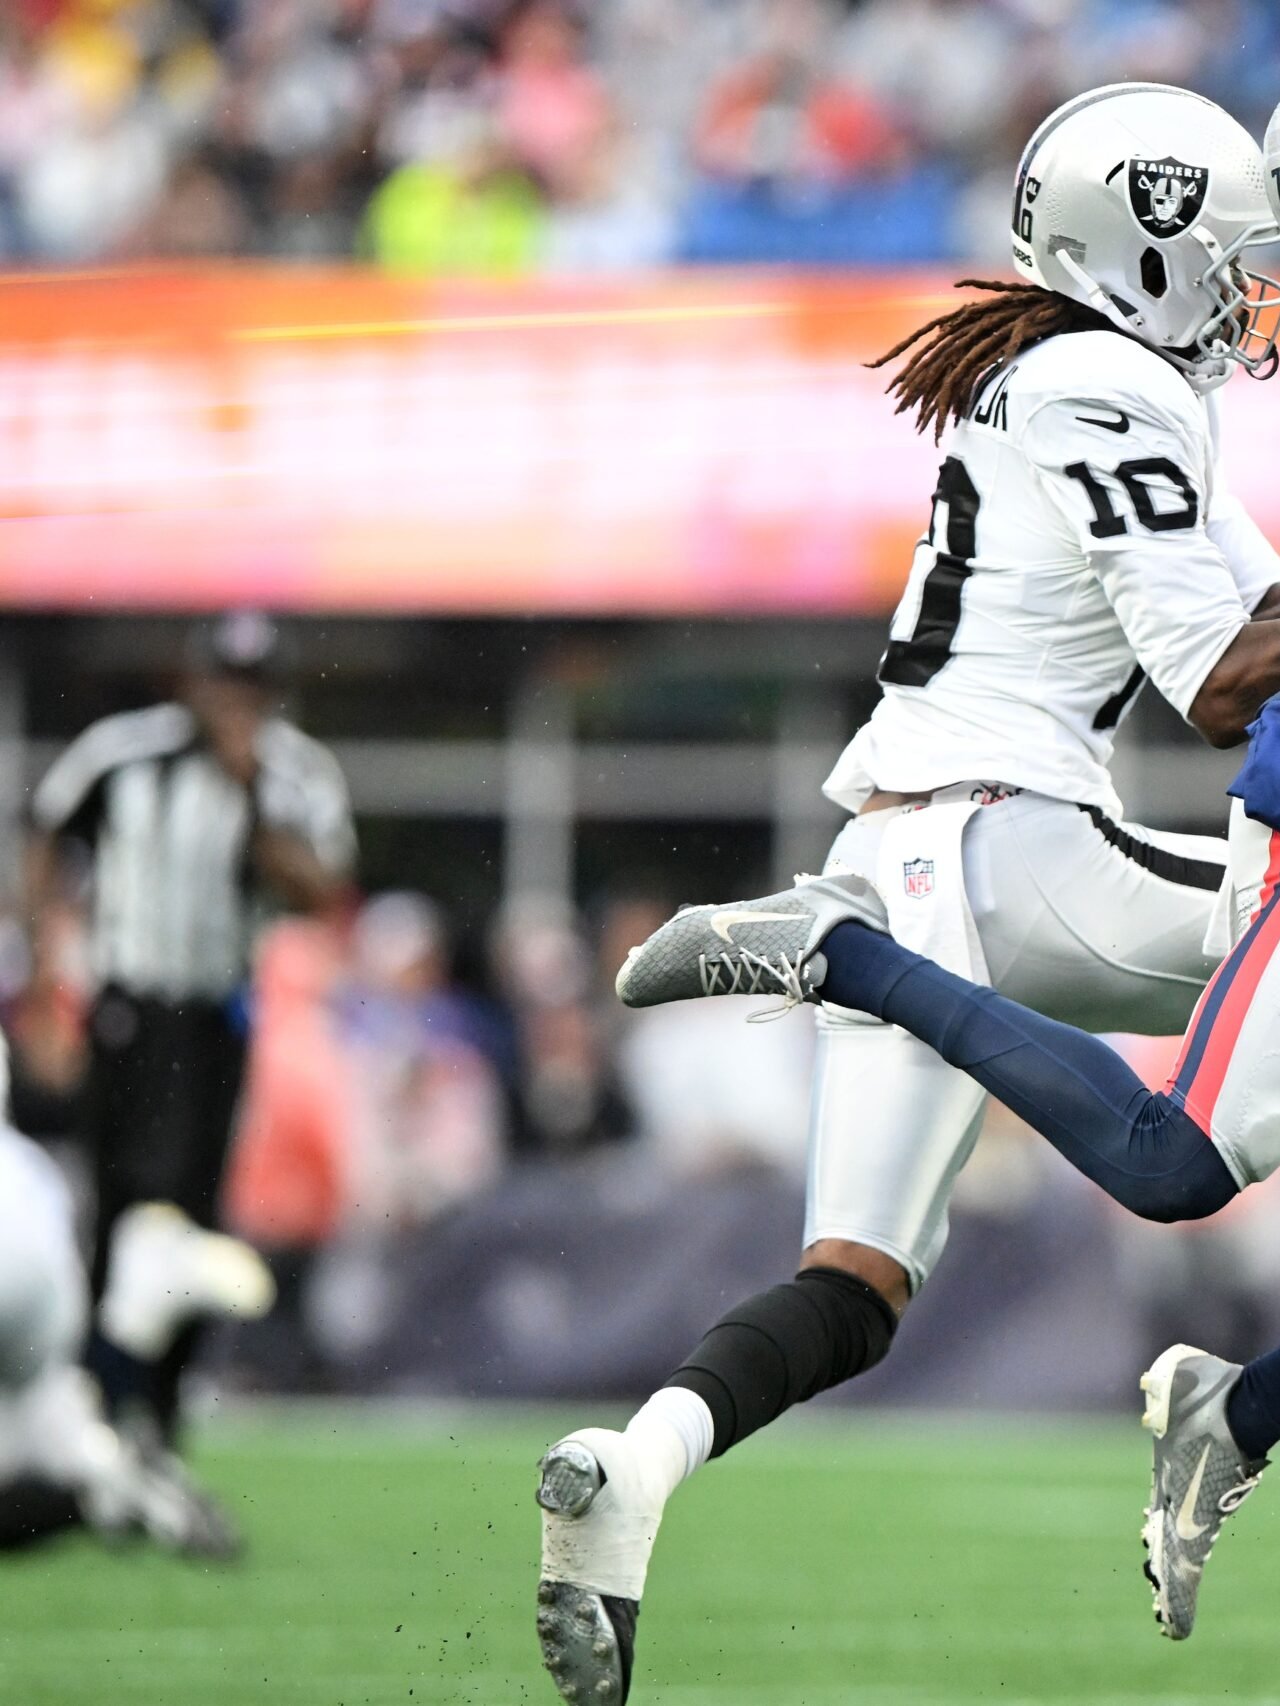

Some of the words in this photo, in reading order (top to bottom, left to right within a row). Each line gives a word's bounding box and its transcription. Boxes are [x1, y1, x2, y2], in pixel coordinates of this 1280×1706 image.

[1137, 160, 1203, 179] RAIDERS
[1064, 457, 1199, 538] 10
[908, 875, 932, 894] NFL
